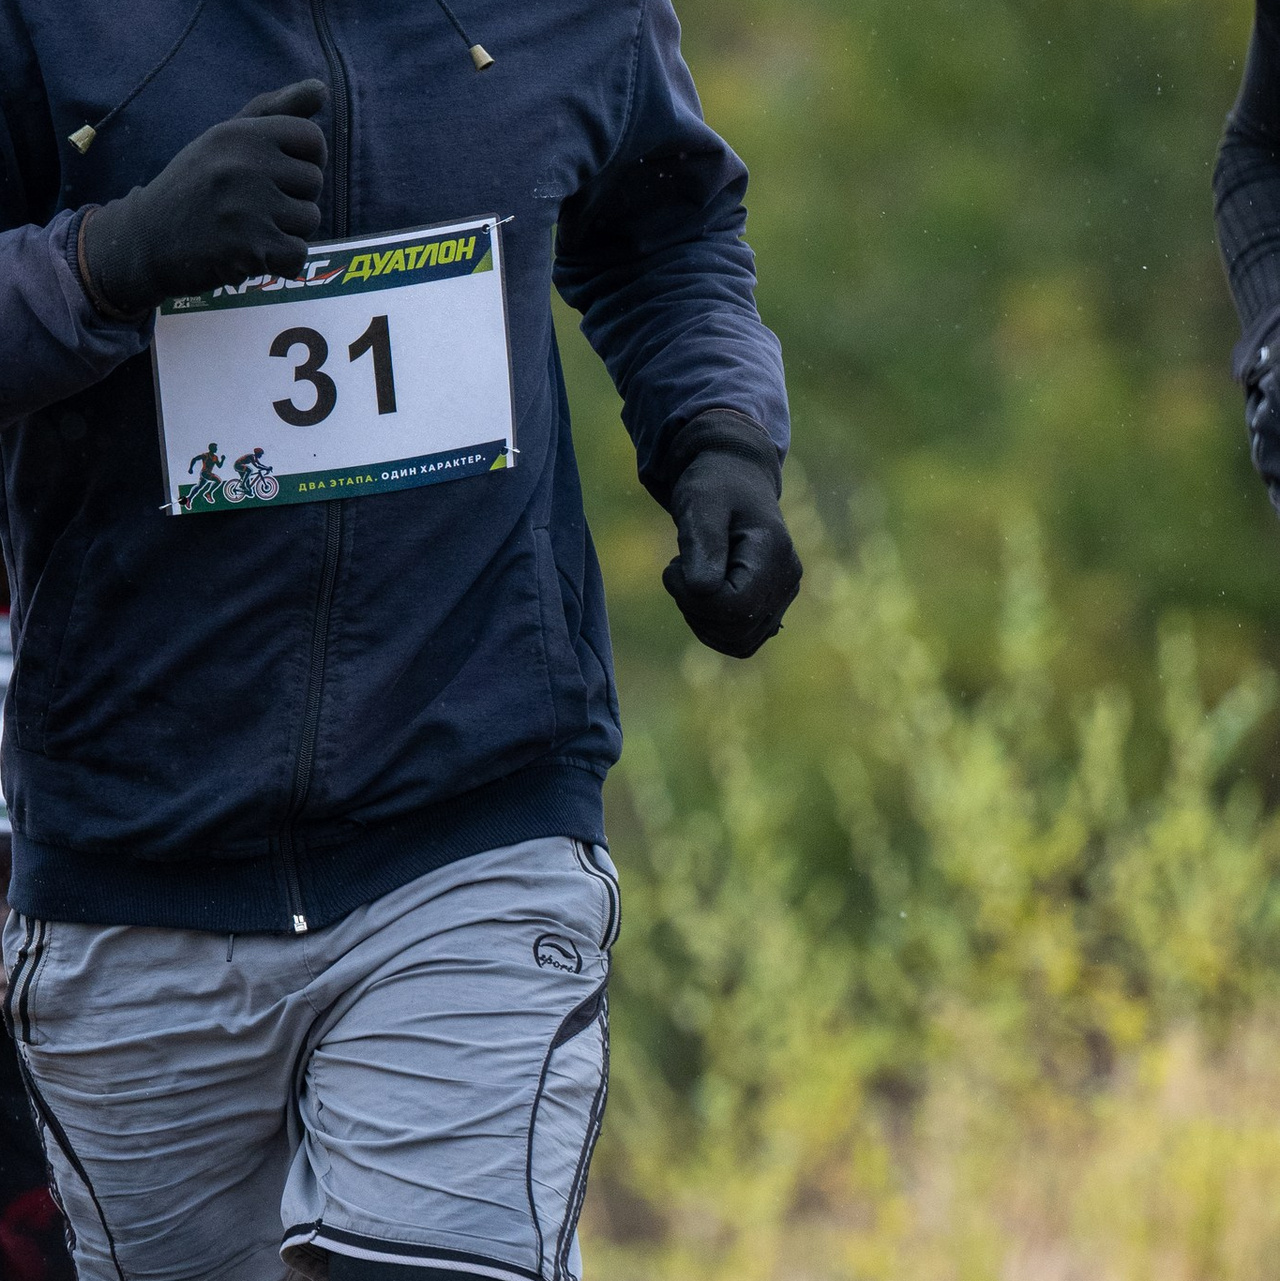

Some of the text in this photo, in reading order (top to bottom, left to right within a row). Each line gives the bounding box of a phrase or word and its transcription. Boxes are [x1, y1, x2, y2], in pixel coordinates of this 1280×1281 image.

[341, 236, 476, 285] ДУАТЛОН
[269, 315, 397, 427] 31
[298, 454, 486, 492] ДВА ЭТАПА. ОДИН ХАРАКТЕР.
